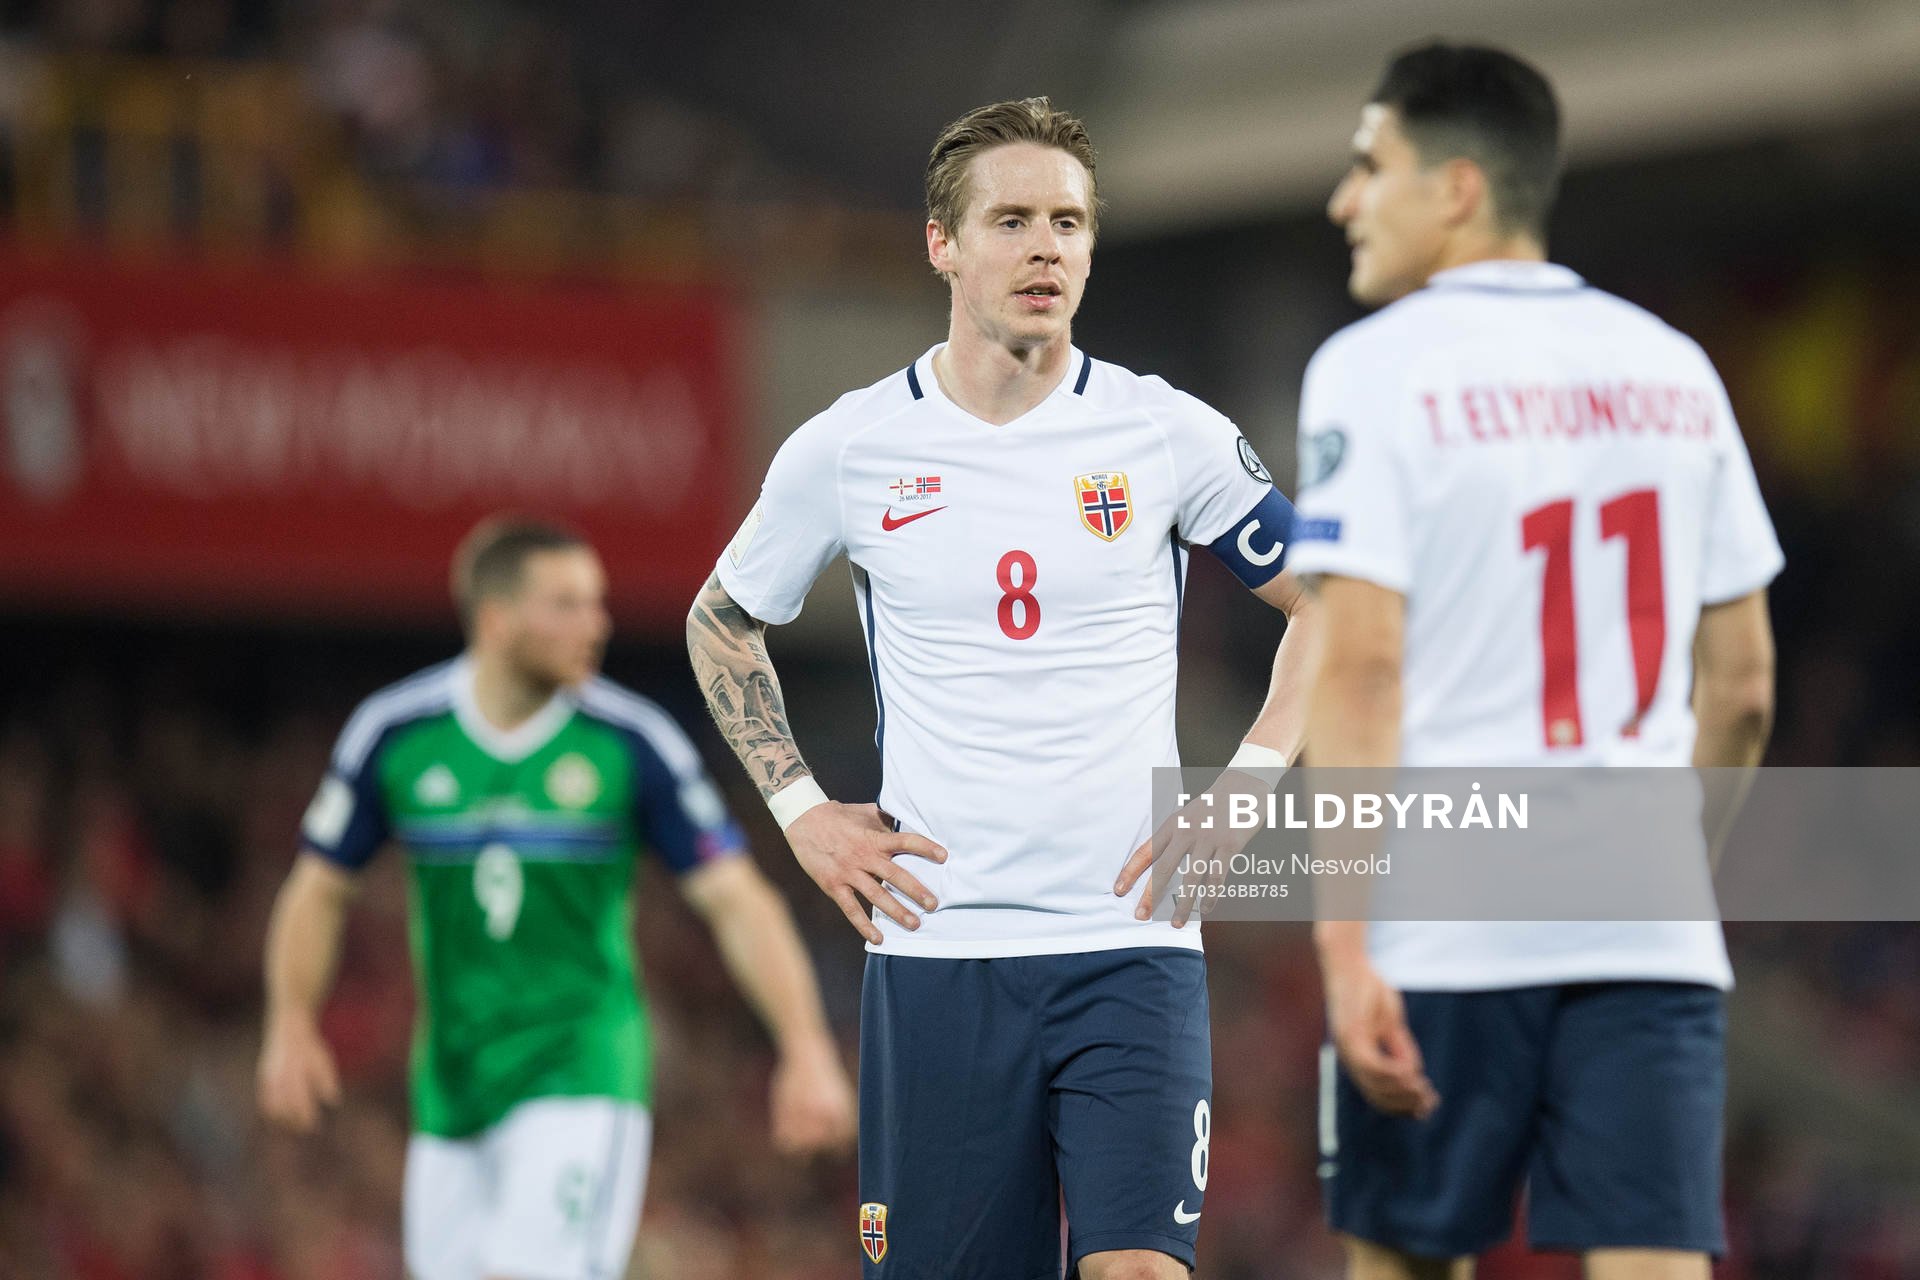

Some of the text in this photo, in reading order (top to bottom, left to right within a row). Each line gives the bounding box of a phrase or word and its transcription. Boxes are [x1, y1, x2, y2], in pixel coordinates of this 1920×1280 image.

[1237, 519, 1284, 566] C
[996, 549, 1041, 640] 8
[1520, 488, 1666, 747] 11
[473, 843, 524, 943] 9
[1191, 1099, 1211, 1191] 8
